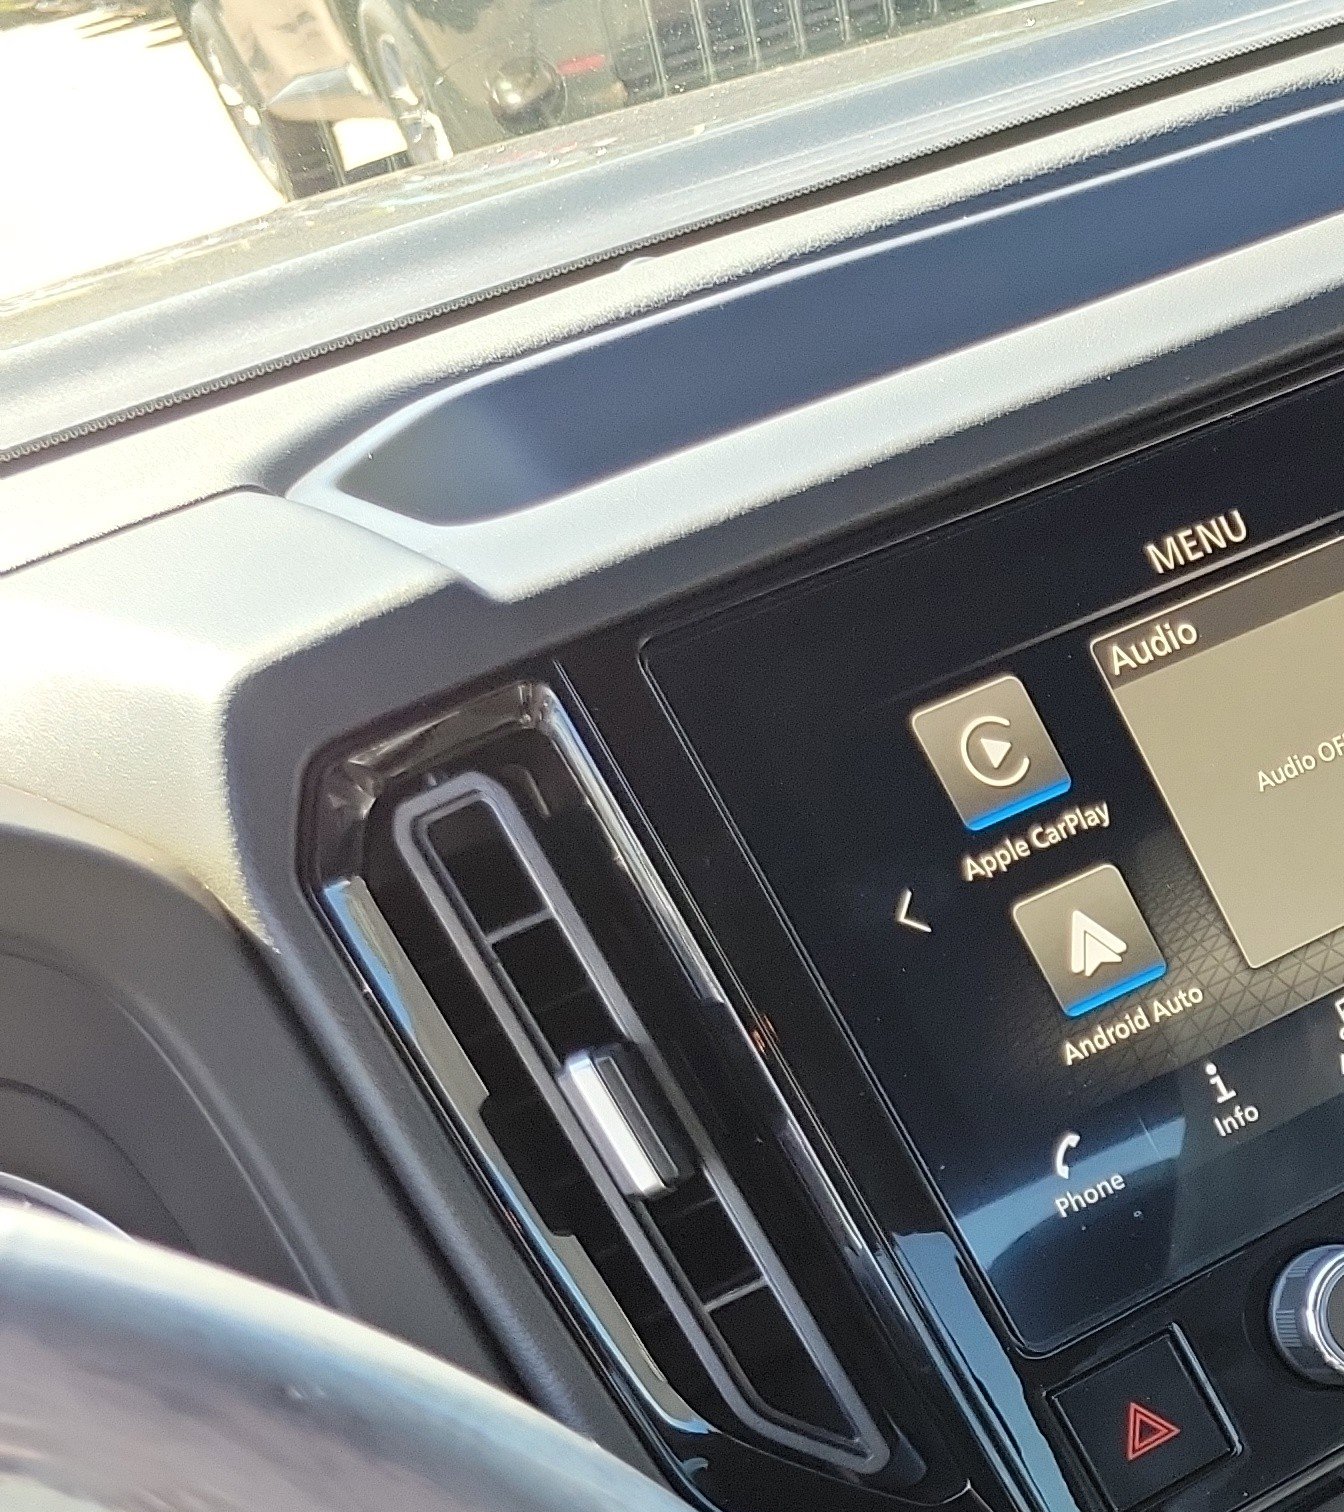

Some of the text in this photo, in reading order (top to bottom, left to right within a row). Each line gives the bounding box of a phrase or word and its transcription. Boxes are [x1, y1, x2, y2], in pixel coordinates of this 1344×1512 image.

[1143, 508, 1248, 576] MENU
[1109, 618, 1199, 676] Audio
[1256, 751, 1316, 793] Audio
[962, 801, 1111, 882] Apple CarPlay
[1062, 984, 1205, 1067] Android Auto
[1212, 1104, 1260, 1138] Info
[1054, 1173, 1126, 1219] Phone
